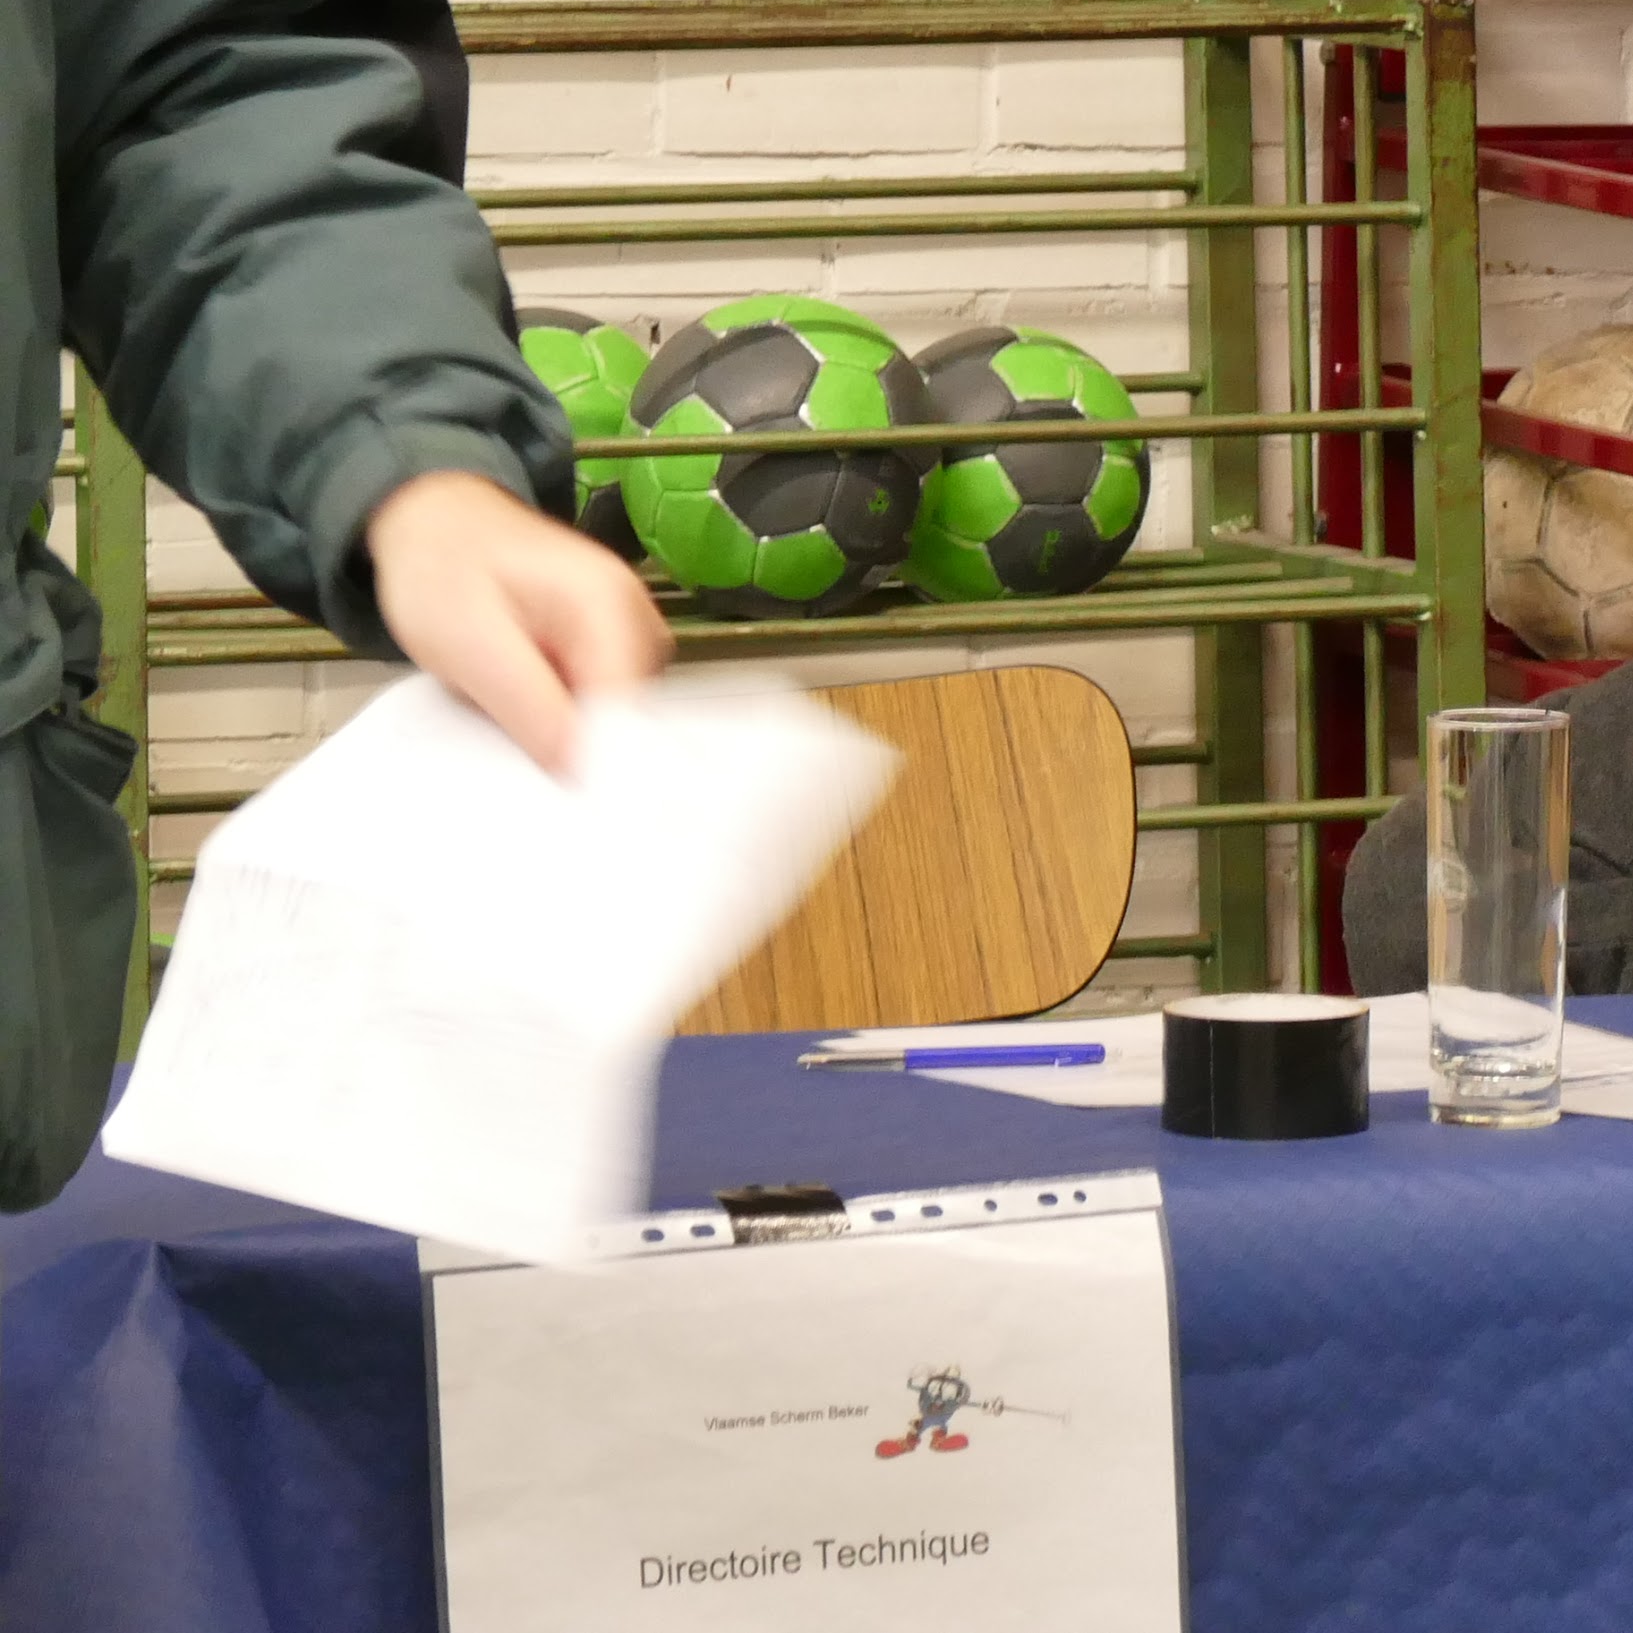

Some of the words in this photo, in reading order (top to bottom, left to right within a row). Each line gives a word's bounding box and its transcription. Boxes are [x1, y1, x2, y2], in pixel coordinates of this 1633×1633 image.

[704, 1414, 766, 1431] Vlaamse
[770, 1409, 825, 1426] Scherm
[828, 1404, 870, 1420] Beker
[640, 1536, 801, 1589] Directoire
[813, 1530, 990, 1570] Technique
